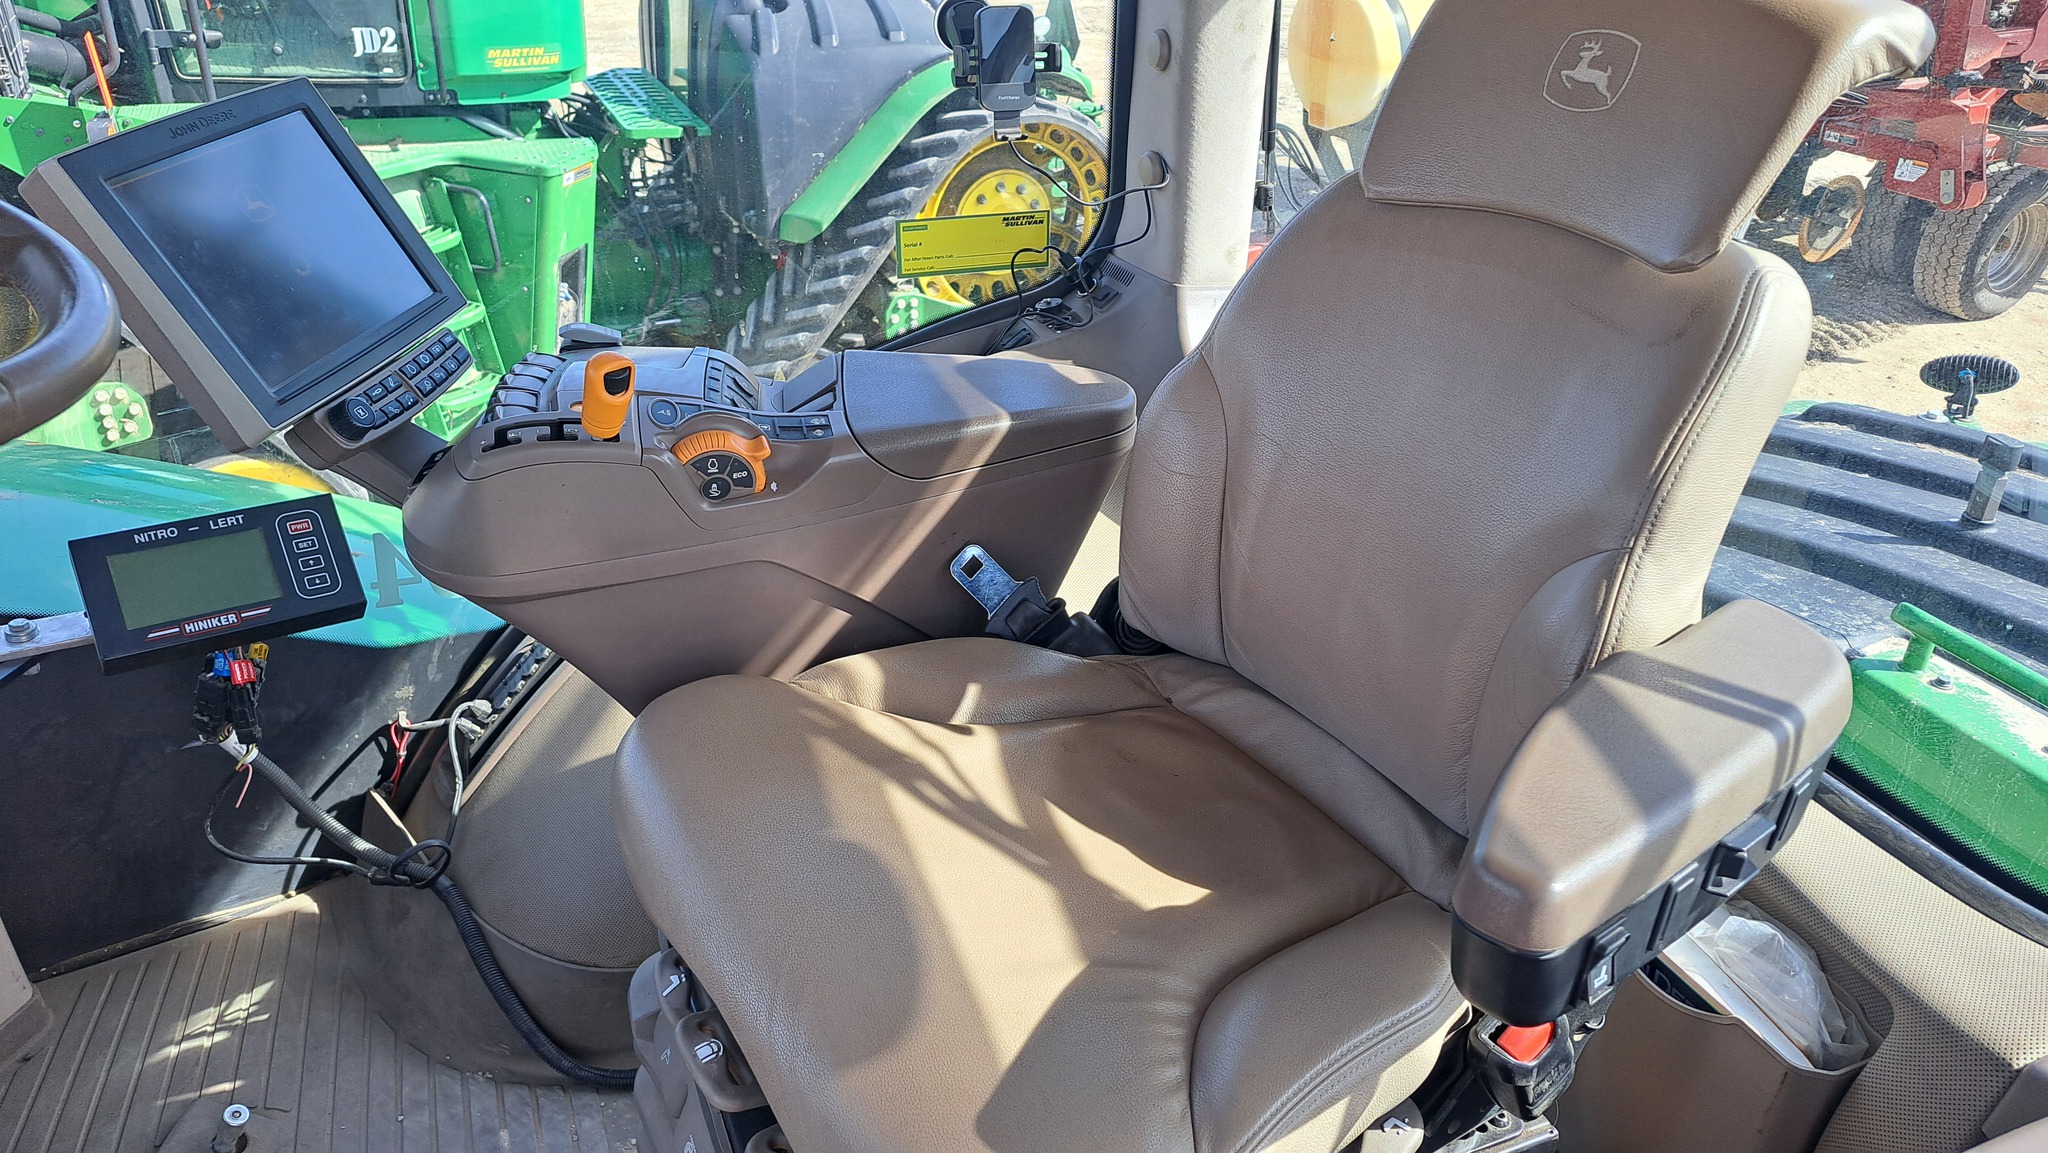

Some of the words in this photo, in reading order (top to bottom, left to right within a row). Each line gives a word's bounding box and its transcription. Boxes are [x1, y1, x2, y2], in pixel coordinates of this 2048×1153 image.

[350, 26, 398, 57] JD2
[487, 46, 545, 58] MARTIN
[493, 55, 560, 68] SULLIVAN
[168, 121, 201, 140] JOHN
[197, 109, 237, 127] DEERE
[1002, 214, 1035, 222] MARTIN
[1004, 219, 1044, 227] SULLIVAN
[733, 470, 748, 479] ECO
[133, 526, 178, 545] NITRO
[209, 514, 245, 530] LERT
[291, 522, 309, 531] PWR
[298, 541, 313, 549] SET
[184, 613, 238, 634] HINIKER
